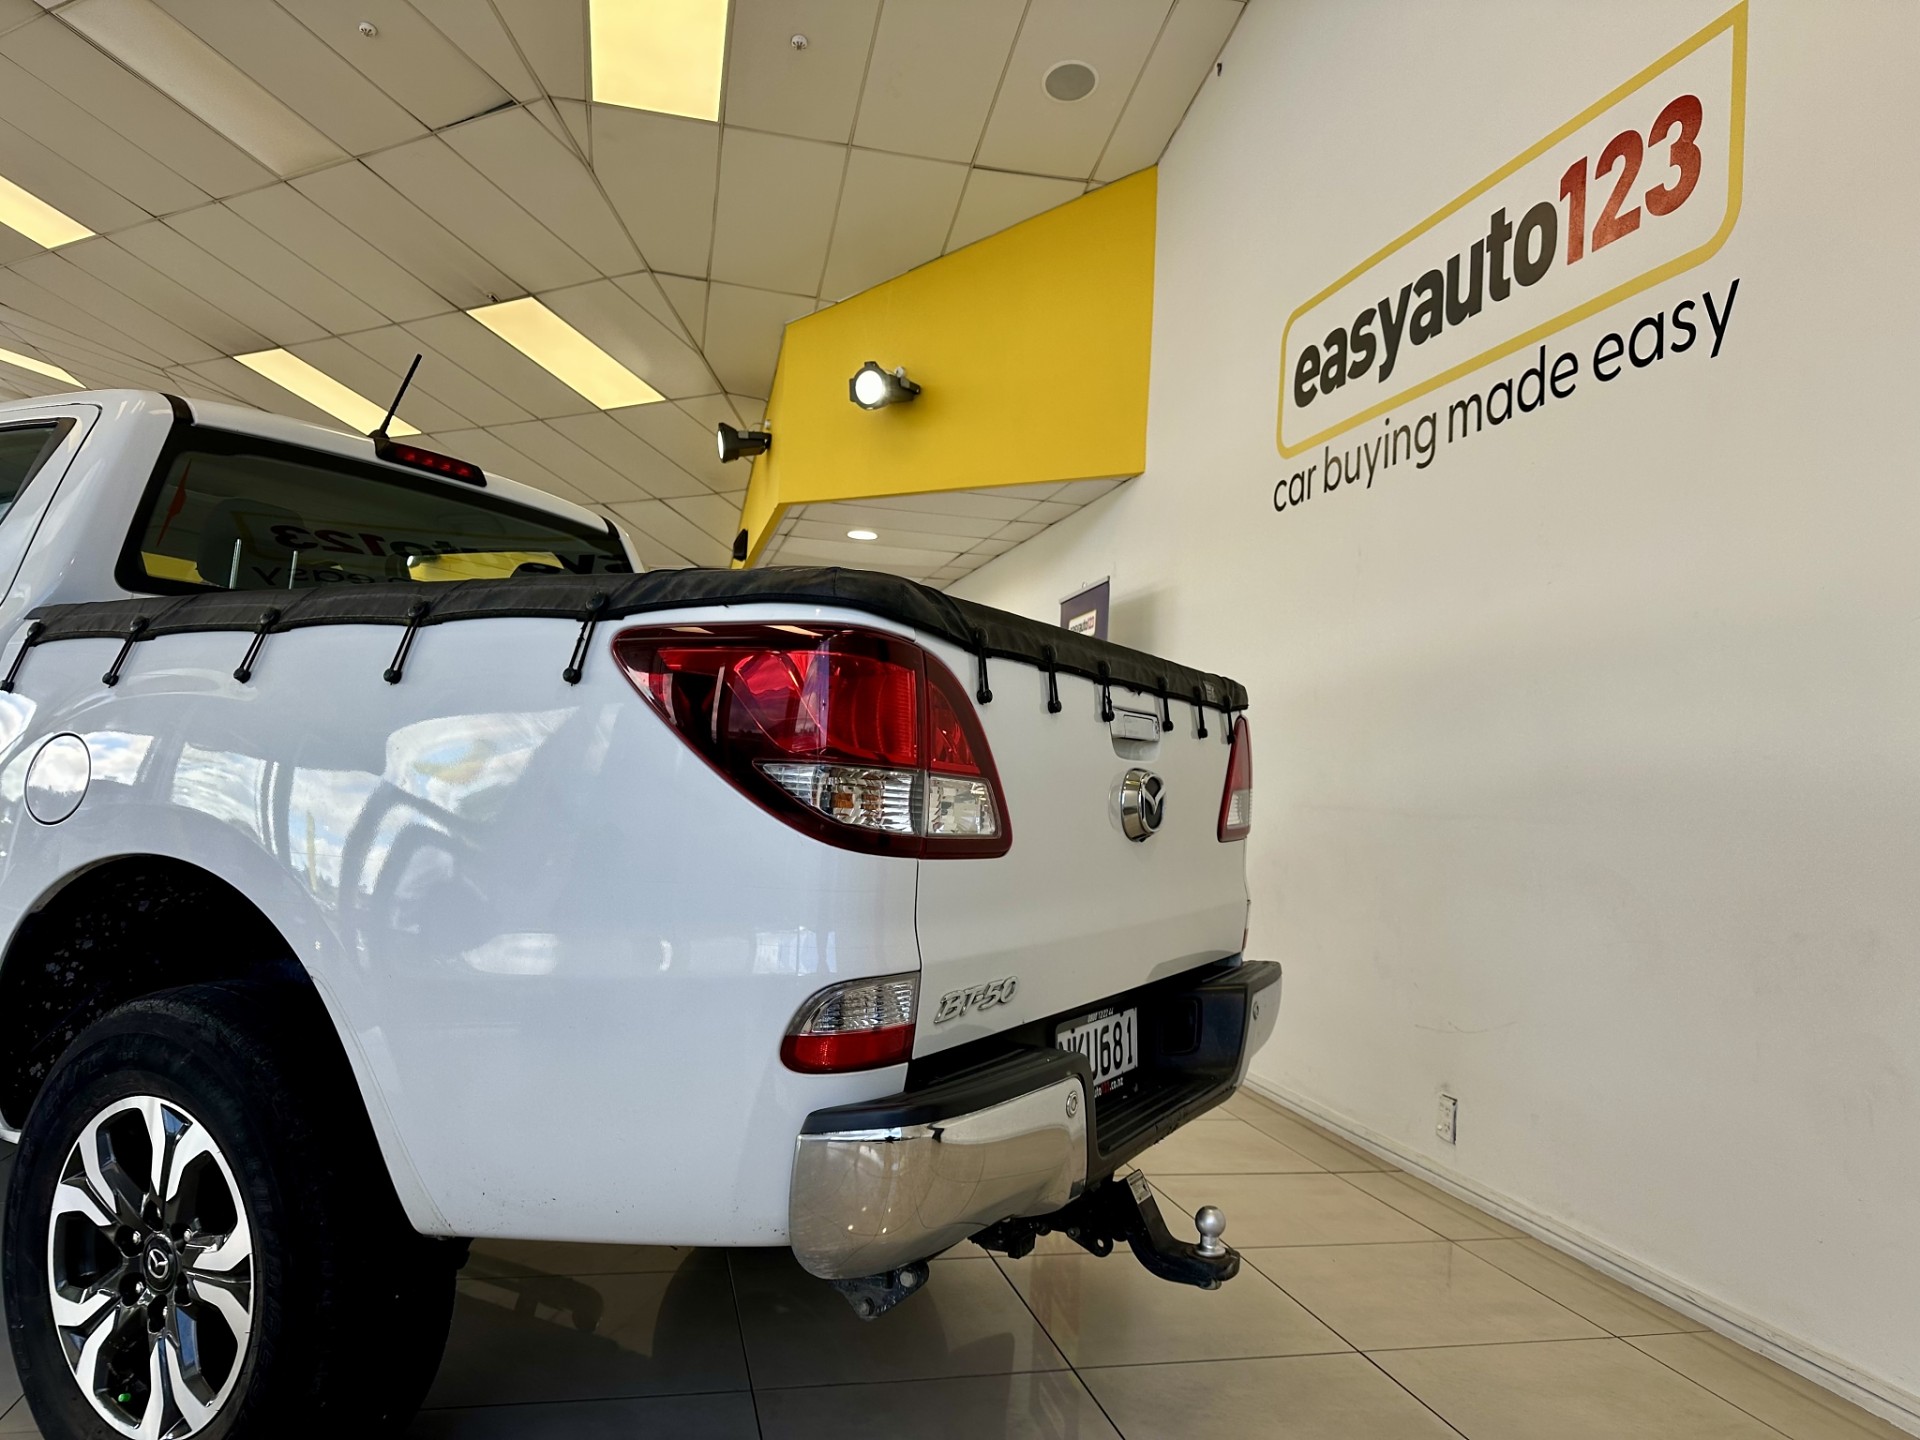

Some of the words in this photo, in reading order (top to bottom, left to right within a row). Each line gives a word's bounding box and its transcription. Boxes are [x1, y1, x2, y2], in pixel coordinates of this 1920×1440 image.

[1293, 94, 1703, 408] easyauto123
[1273, 465, 1317, 513] car
[1323, 412, 1437, 494] buying
[1448, 345, 1579, 444] made
[1592, 278, 1741, 383] easy
[934, 976, 1018, 1024] BT-50
[1059, 1016, 1132, 1080] U681
